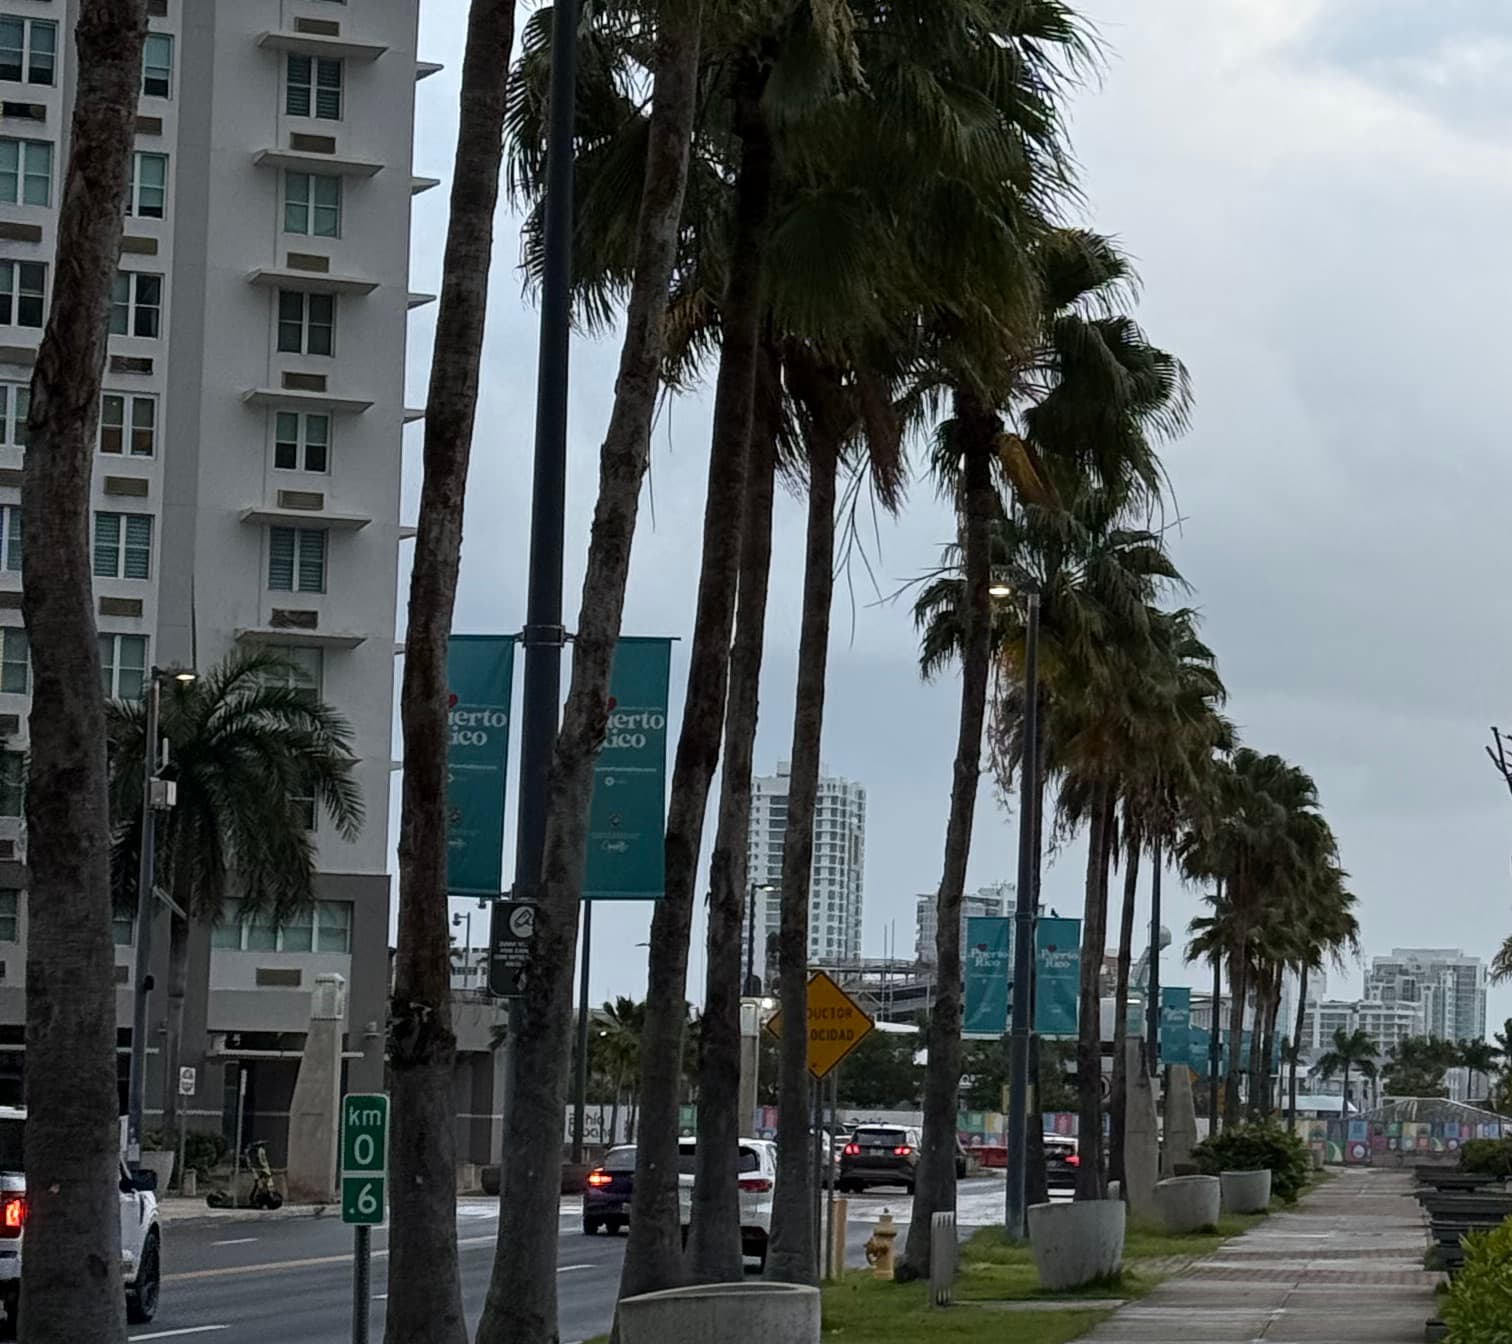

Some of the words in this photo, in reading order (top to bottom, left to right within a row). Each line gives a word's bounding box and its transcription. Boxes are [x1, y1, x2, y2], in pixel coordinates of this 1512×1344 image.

[449, 725, 488, 746] ico
[807, 1007, 853, 1020] DUCTOR
[810, 1029, 854, 1041] OCIDAD
[348, 1106, 382, 1126] km
[354, 1134, 374, 1165] 0
[348, 1183, 377, 1214] .6
